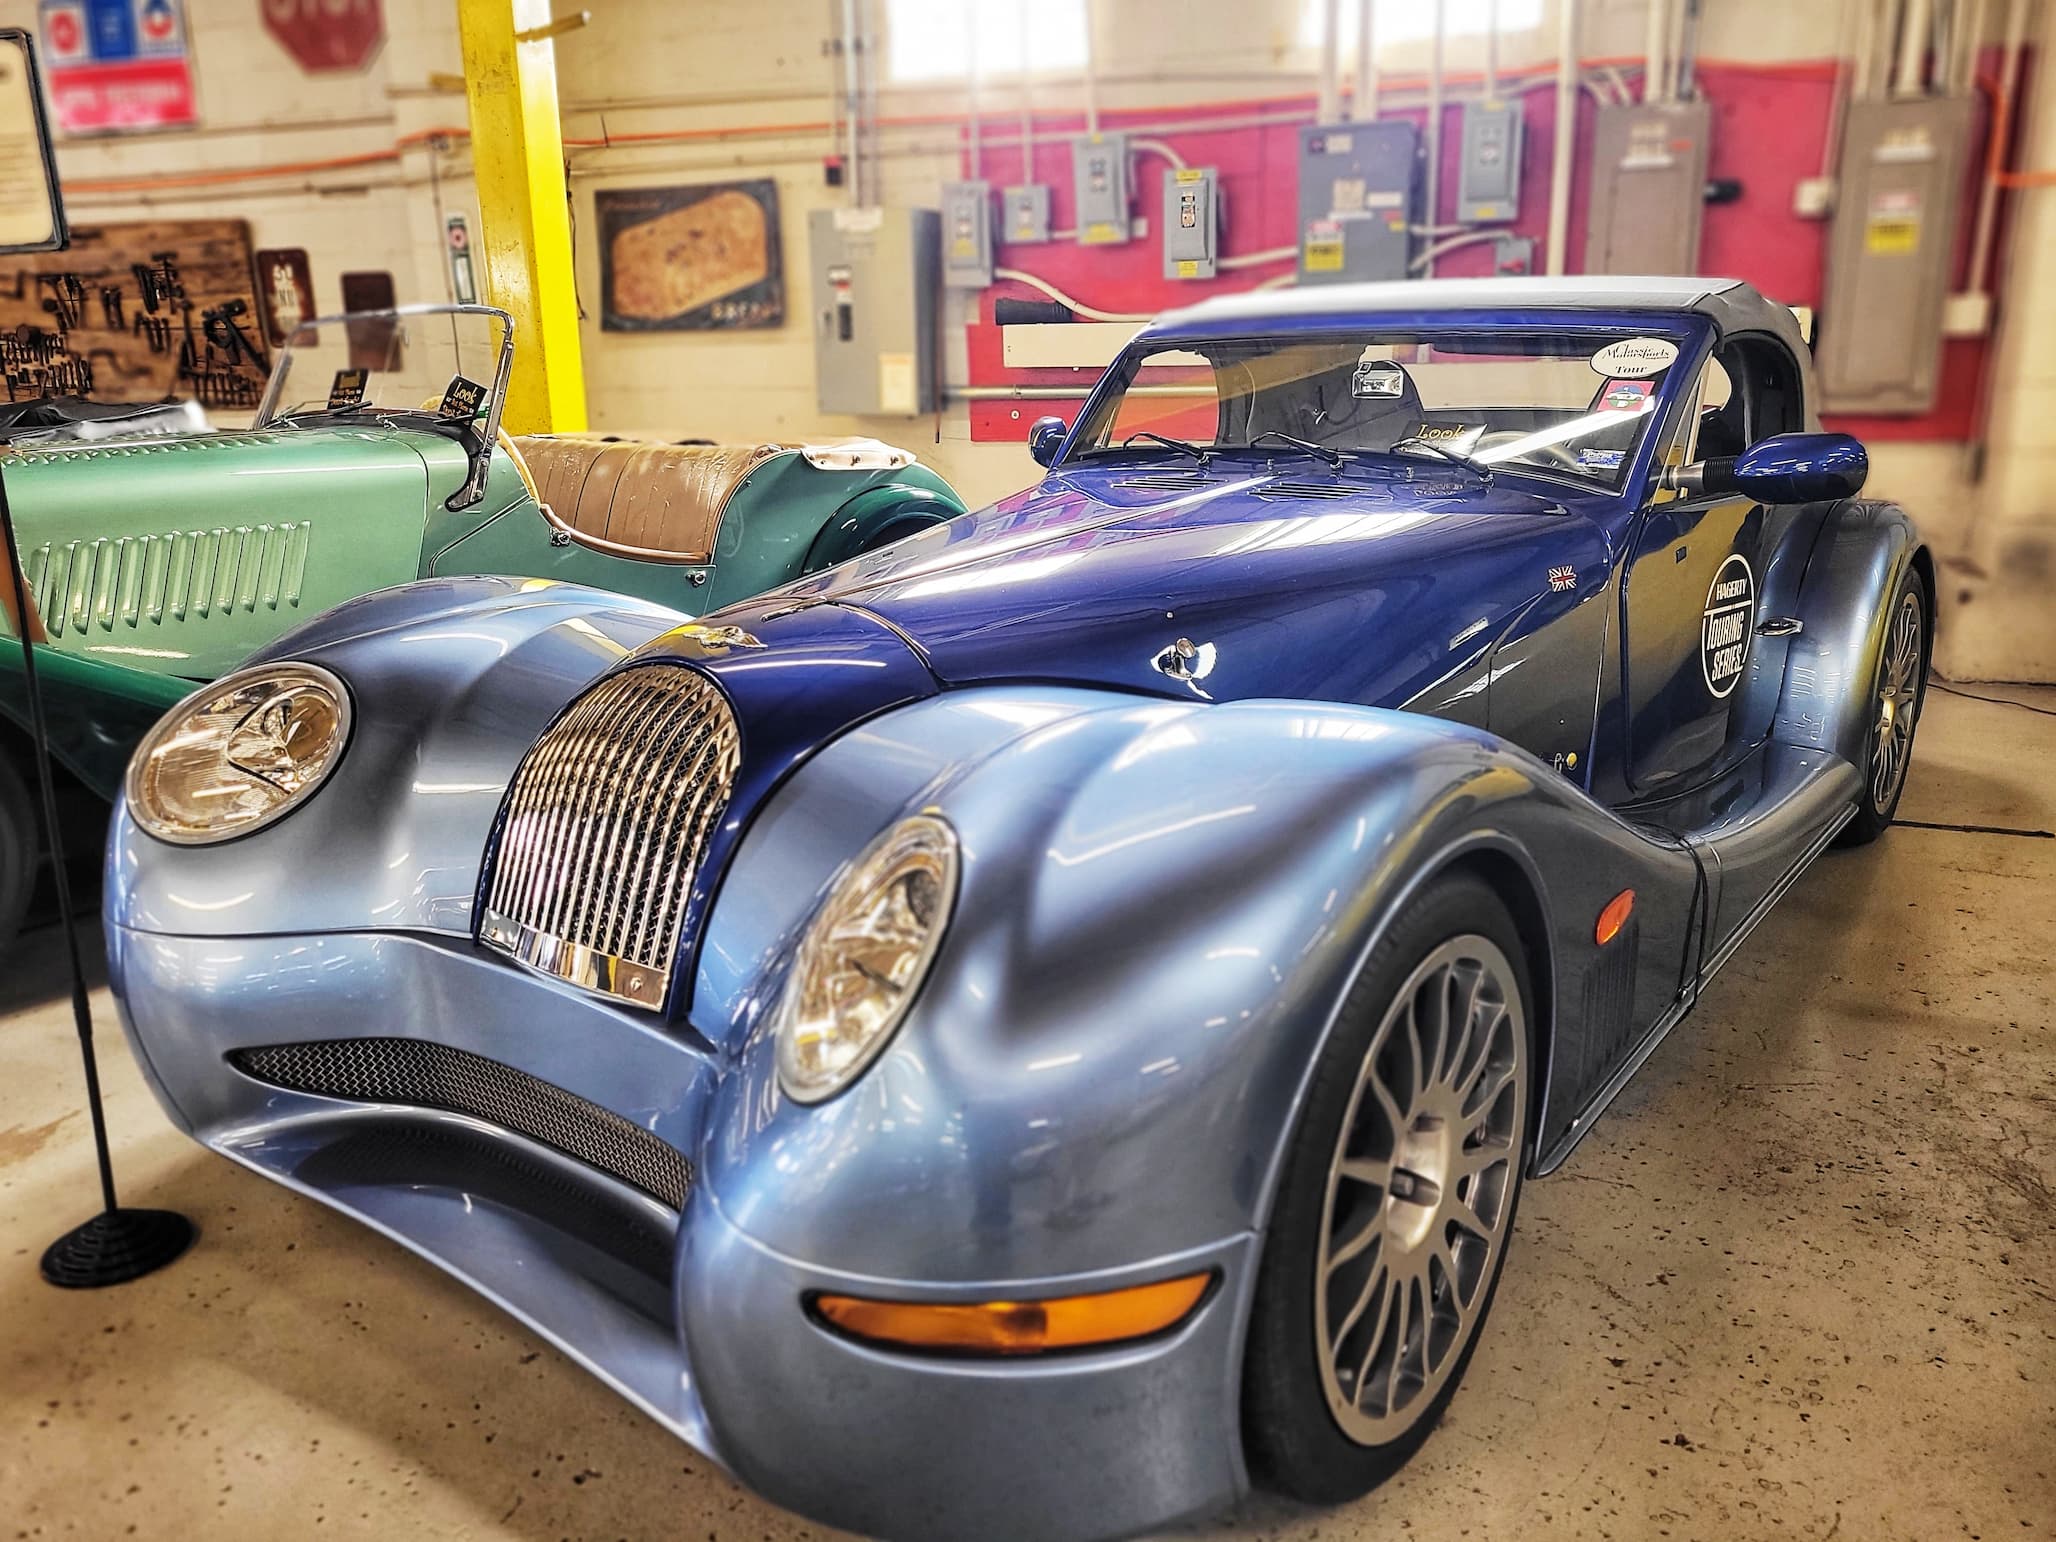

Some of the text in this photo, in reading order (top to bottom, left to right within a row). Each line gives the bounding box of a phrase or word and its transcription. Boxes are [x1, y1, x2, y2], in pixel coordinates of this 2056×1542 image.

[1615, 365, 1648, 374] Tour
[453, 381, 479, 405] Look
[1415, 423, 1465, 441] Look
[1716, 578, 1748, 601] HAGERTY
[1704, 603, 1749, 651] TOURING
[1711, 643, 1744, 682] SERIES
